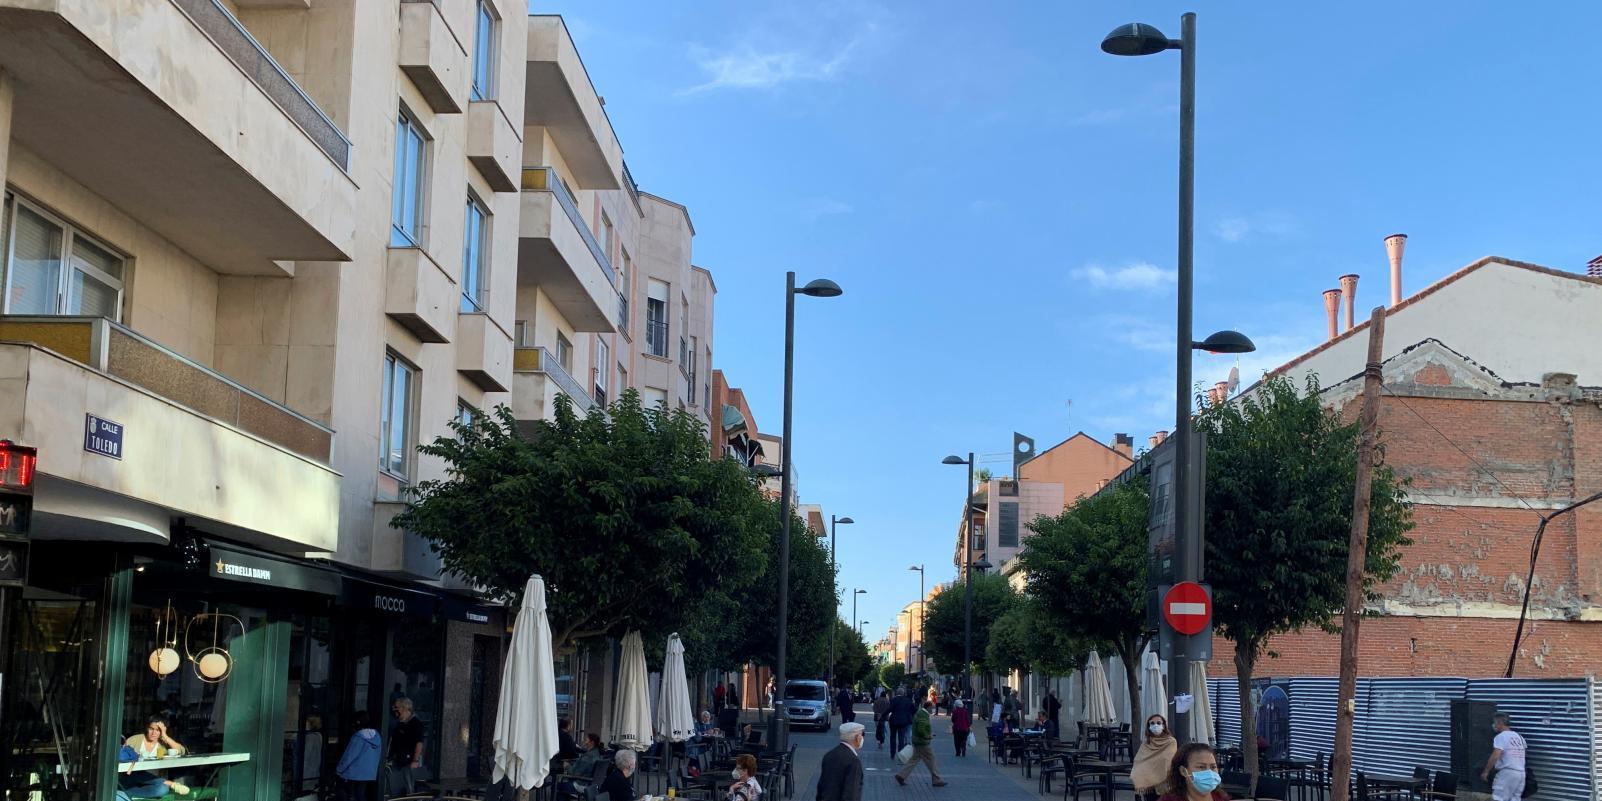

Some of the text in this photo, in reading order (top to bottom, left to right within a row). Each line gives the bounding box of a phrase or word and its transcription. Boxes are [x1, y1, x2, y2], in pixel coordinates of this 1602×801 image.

[101, 421, 119, 435] CALLE
[91, 435, 118, 455] TOLEDO
[224, 563, 271, 580] ESTRELLA DAMM
